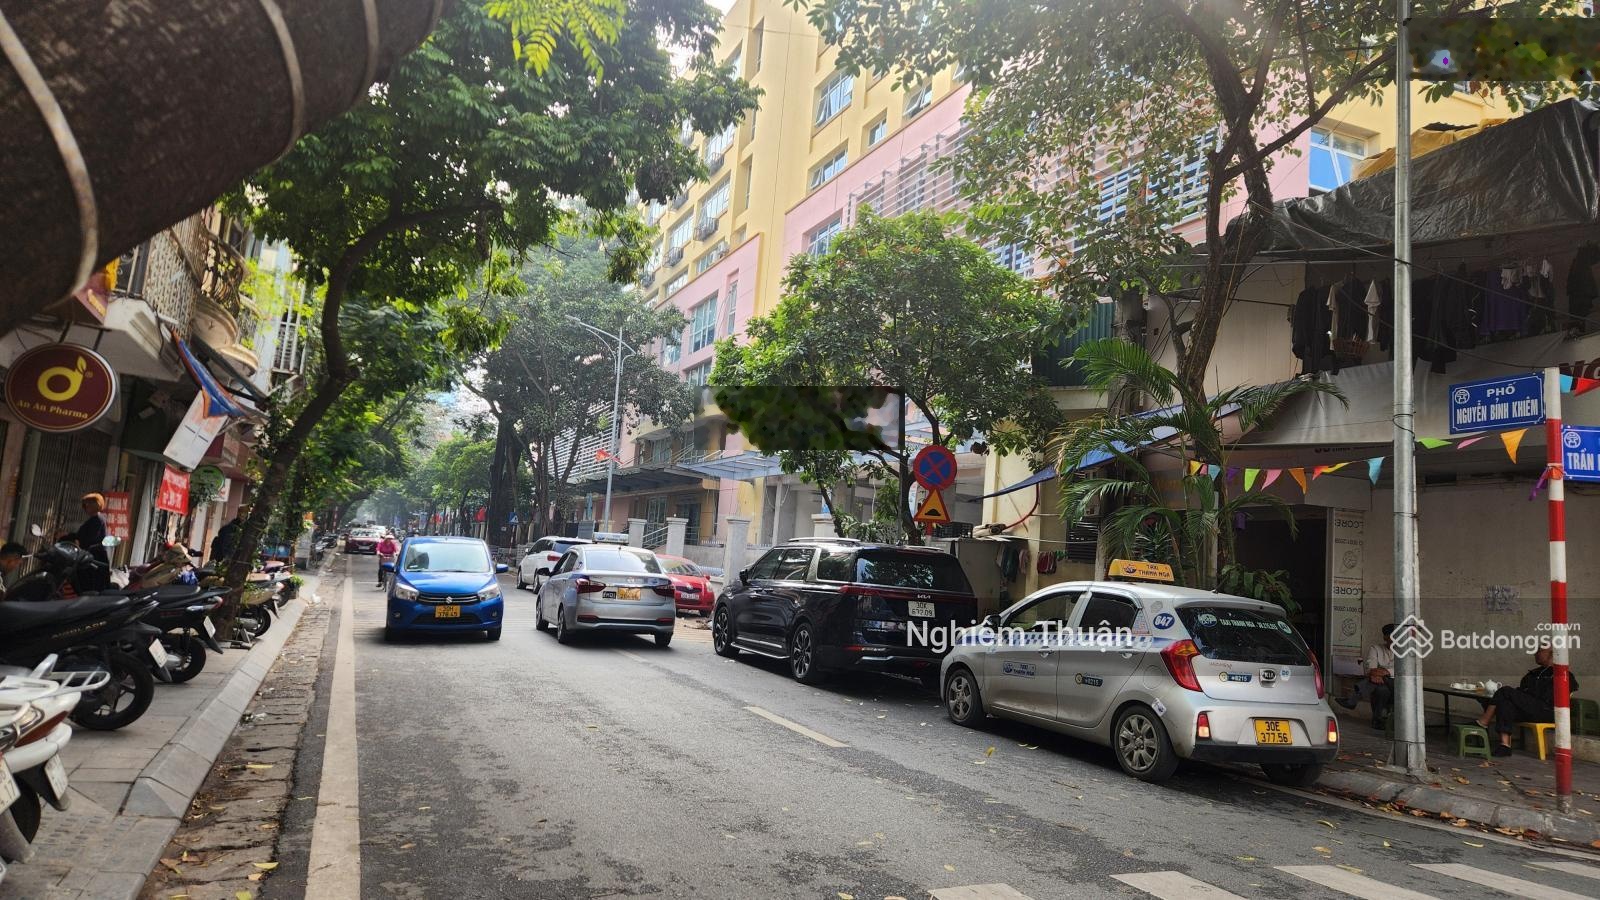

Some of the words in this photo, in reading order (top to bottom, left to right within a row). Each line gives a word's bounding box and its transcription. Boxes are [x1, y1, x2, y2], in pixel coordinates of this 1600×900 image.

[1486, 382, 1516, 397] PHỐ
[17, 400, 30, 408] An
[33, 403, 47, 411] An
[49, 405, 88, 419] Pharma
[1456, 400, 1487, 425] NGUYỄN
[1512, 396, 1538, 418] KHIÊM
[1154, 615, 1173, 627] 647
[1265, 721, 1280, 731] 30E
[1261, 732, 1288, 743] 377.56
